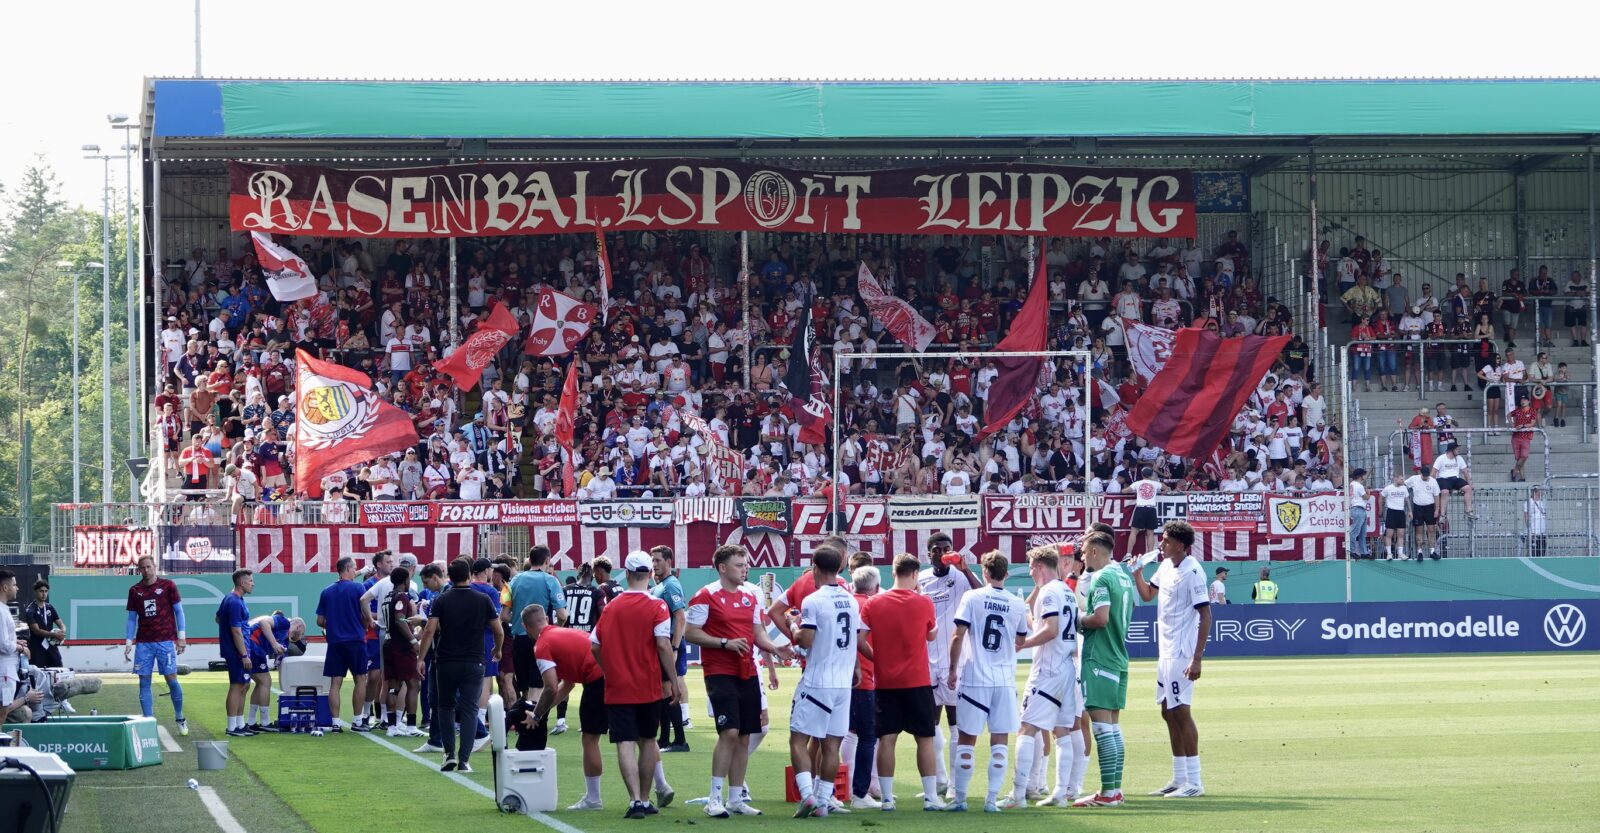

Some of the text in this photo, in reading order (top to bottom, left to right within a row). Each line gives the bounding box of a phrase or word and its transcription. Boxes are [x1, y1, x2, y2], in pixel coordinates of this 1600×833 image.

[914, 172, 1184, 233] LEIPZIG
[1014, 495, 1044, 507] ZONE
[1240, 494, 1263, 502] LEBEN
[440, 504, 499, 522] FORUM
[501, 502, 576, 515] Visionen erleben
[891, 506, 977, 518] rasenballisten
[1308, 500, 1336, 514] Holy
[991, 501, 1082, 529] ZONE
[1310, 516, 1345, 529] Leipzig
[77, 530, 153, 565] DELITZSCH
[188, 541, 209, 549] WILD
[566, 596, 593, 625] 49
[834, 600, 851, 609] KOLBE
[984, 601, 1010, 613] TARNAT
[836, 612, 851, 650] 3
[981, 614, 1003, 651] 6
[1123, 615, 1520, 643] ERGY Sondermodelle
[1170, 681, 1180, 695] 8
[38, 743, 109, 754] DFB-POKAL
